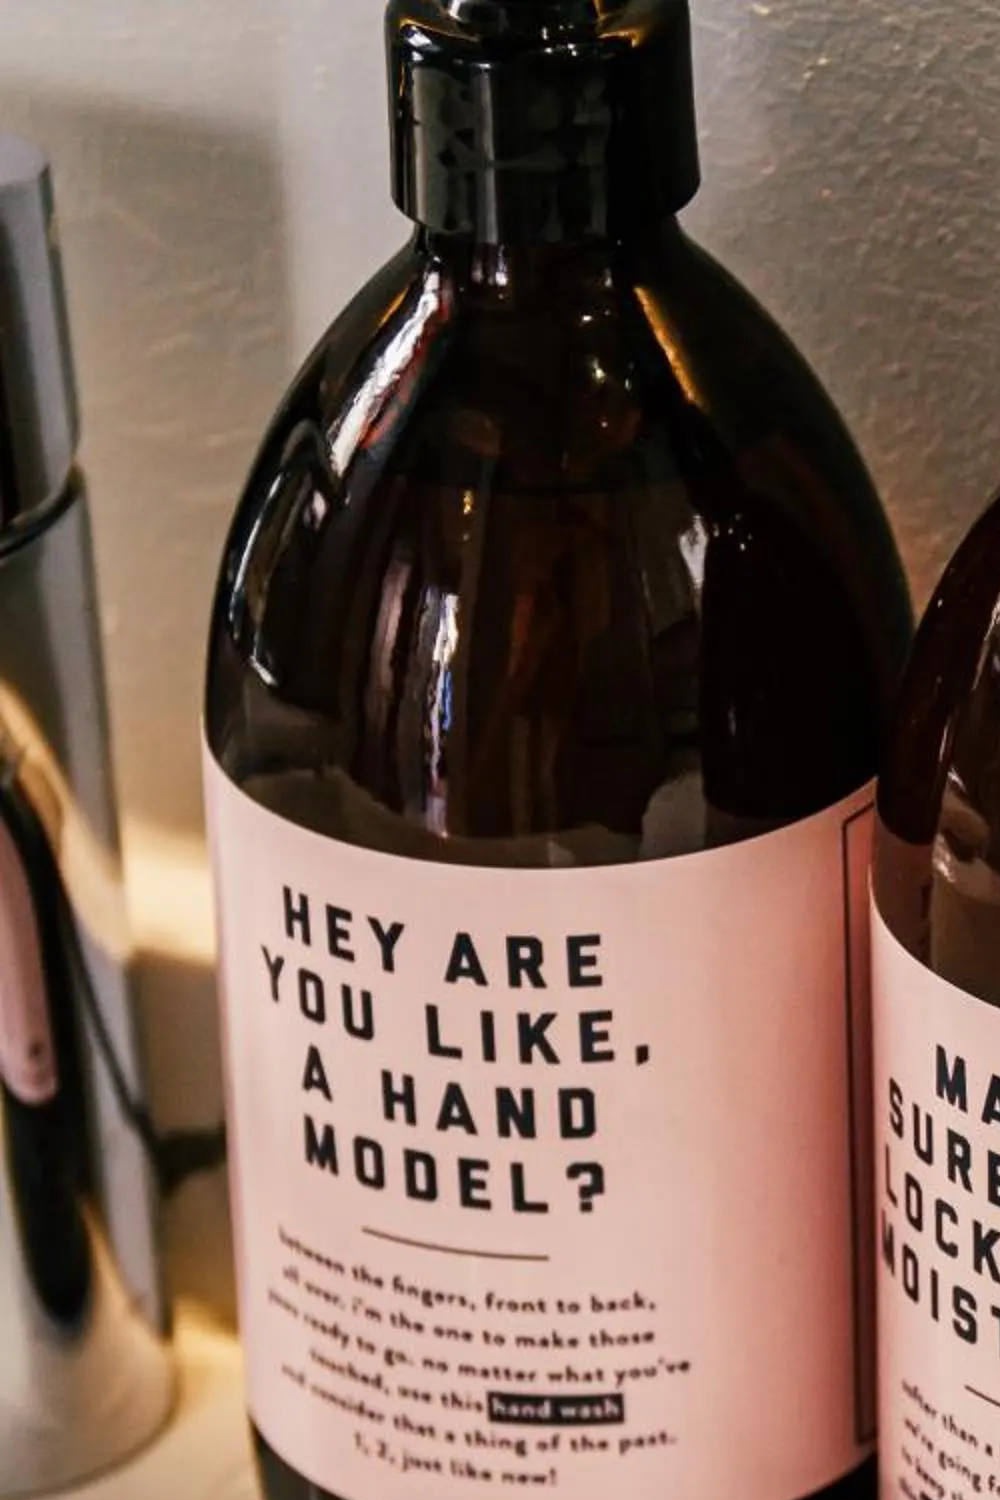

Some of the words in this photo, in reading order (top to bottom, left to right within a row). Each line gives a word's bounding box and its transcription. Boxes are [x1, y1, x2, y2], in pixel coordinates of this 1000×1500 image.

[283, 885, 404, 973] HEY
[445, 932, 602, 988] ARE
[260, 944, 374, 1040] YOU
[425, 1004, 650, 1065] LIKE,
[303, 1044, 333, 1102] A
[381, 1069, 596, 1139] HAND
[304, 1114, 605, 1213] MODEL?
[278, 1223, 345, 1276] between
[352, 1265, 384, 1288] the
[485, 1290, 546, 1313] front
[556, 1299, 580, 1313] to
[303, 1313, 349, 1350] ready
[356, 1336, 376, 1355] to
[421, 1357, 448, 1373] no
[458, 1363, 536, 1382] matter
[547, 1364, 604, 1382] what
[615, 1357, 690, 1388] you've
[389, 1311, 424, 1333] the
[433, 1325, 473, 1342] one
[482, 1329, 505, 1346] to
[515, 1329, 579, 1348] make
[589, 1328, 655, 1348] those
[398, 1386, 432, 1403] use
[440, 1391, 483, 1413] this
[492, 1396, 551, 1418] hand
[559, 1398, 620, 1418] wash
[393, 1413, 435, 1438] that
[445, 1431, 455, 1444] a
[464, 1430, 527, 1456] thing
[535, 1433, 560, 1452] of
[569, 1435, 609, 1452] the
[941, 1413, 979, 1448] than
[985, 1443, 993, 1456] a
[401, 1450, 442, 1472] just
[450, 1459, 493, 1482] like
[501, 1467, 557, 1487] new!
[938, 1450, 982, 1493] going
